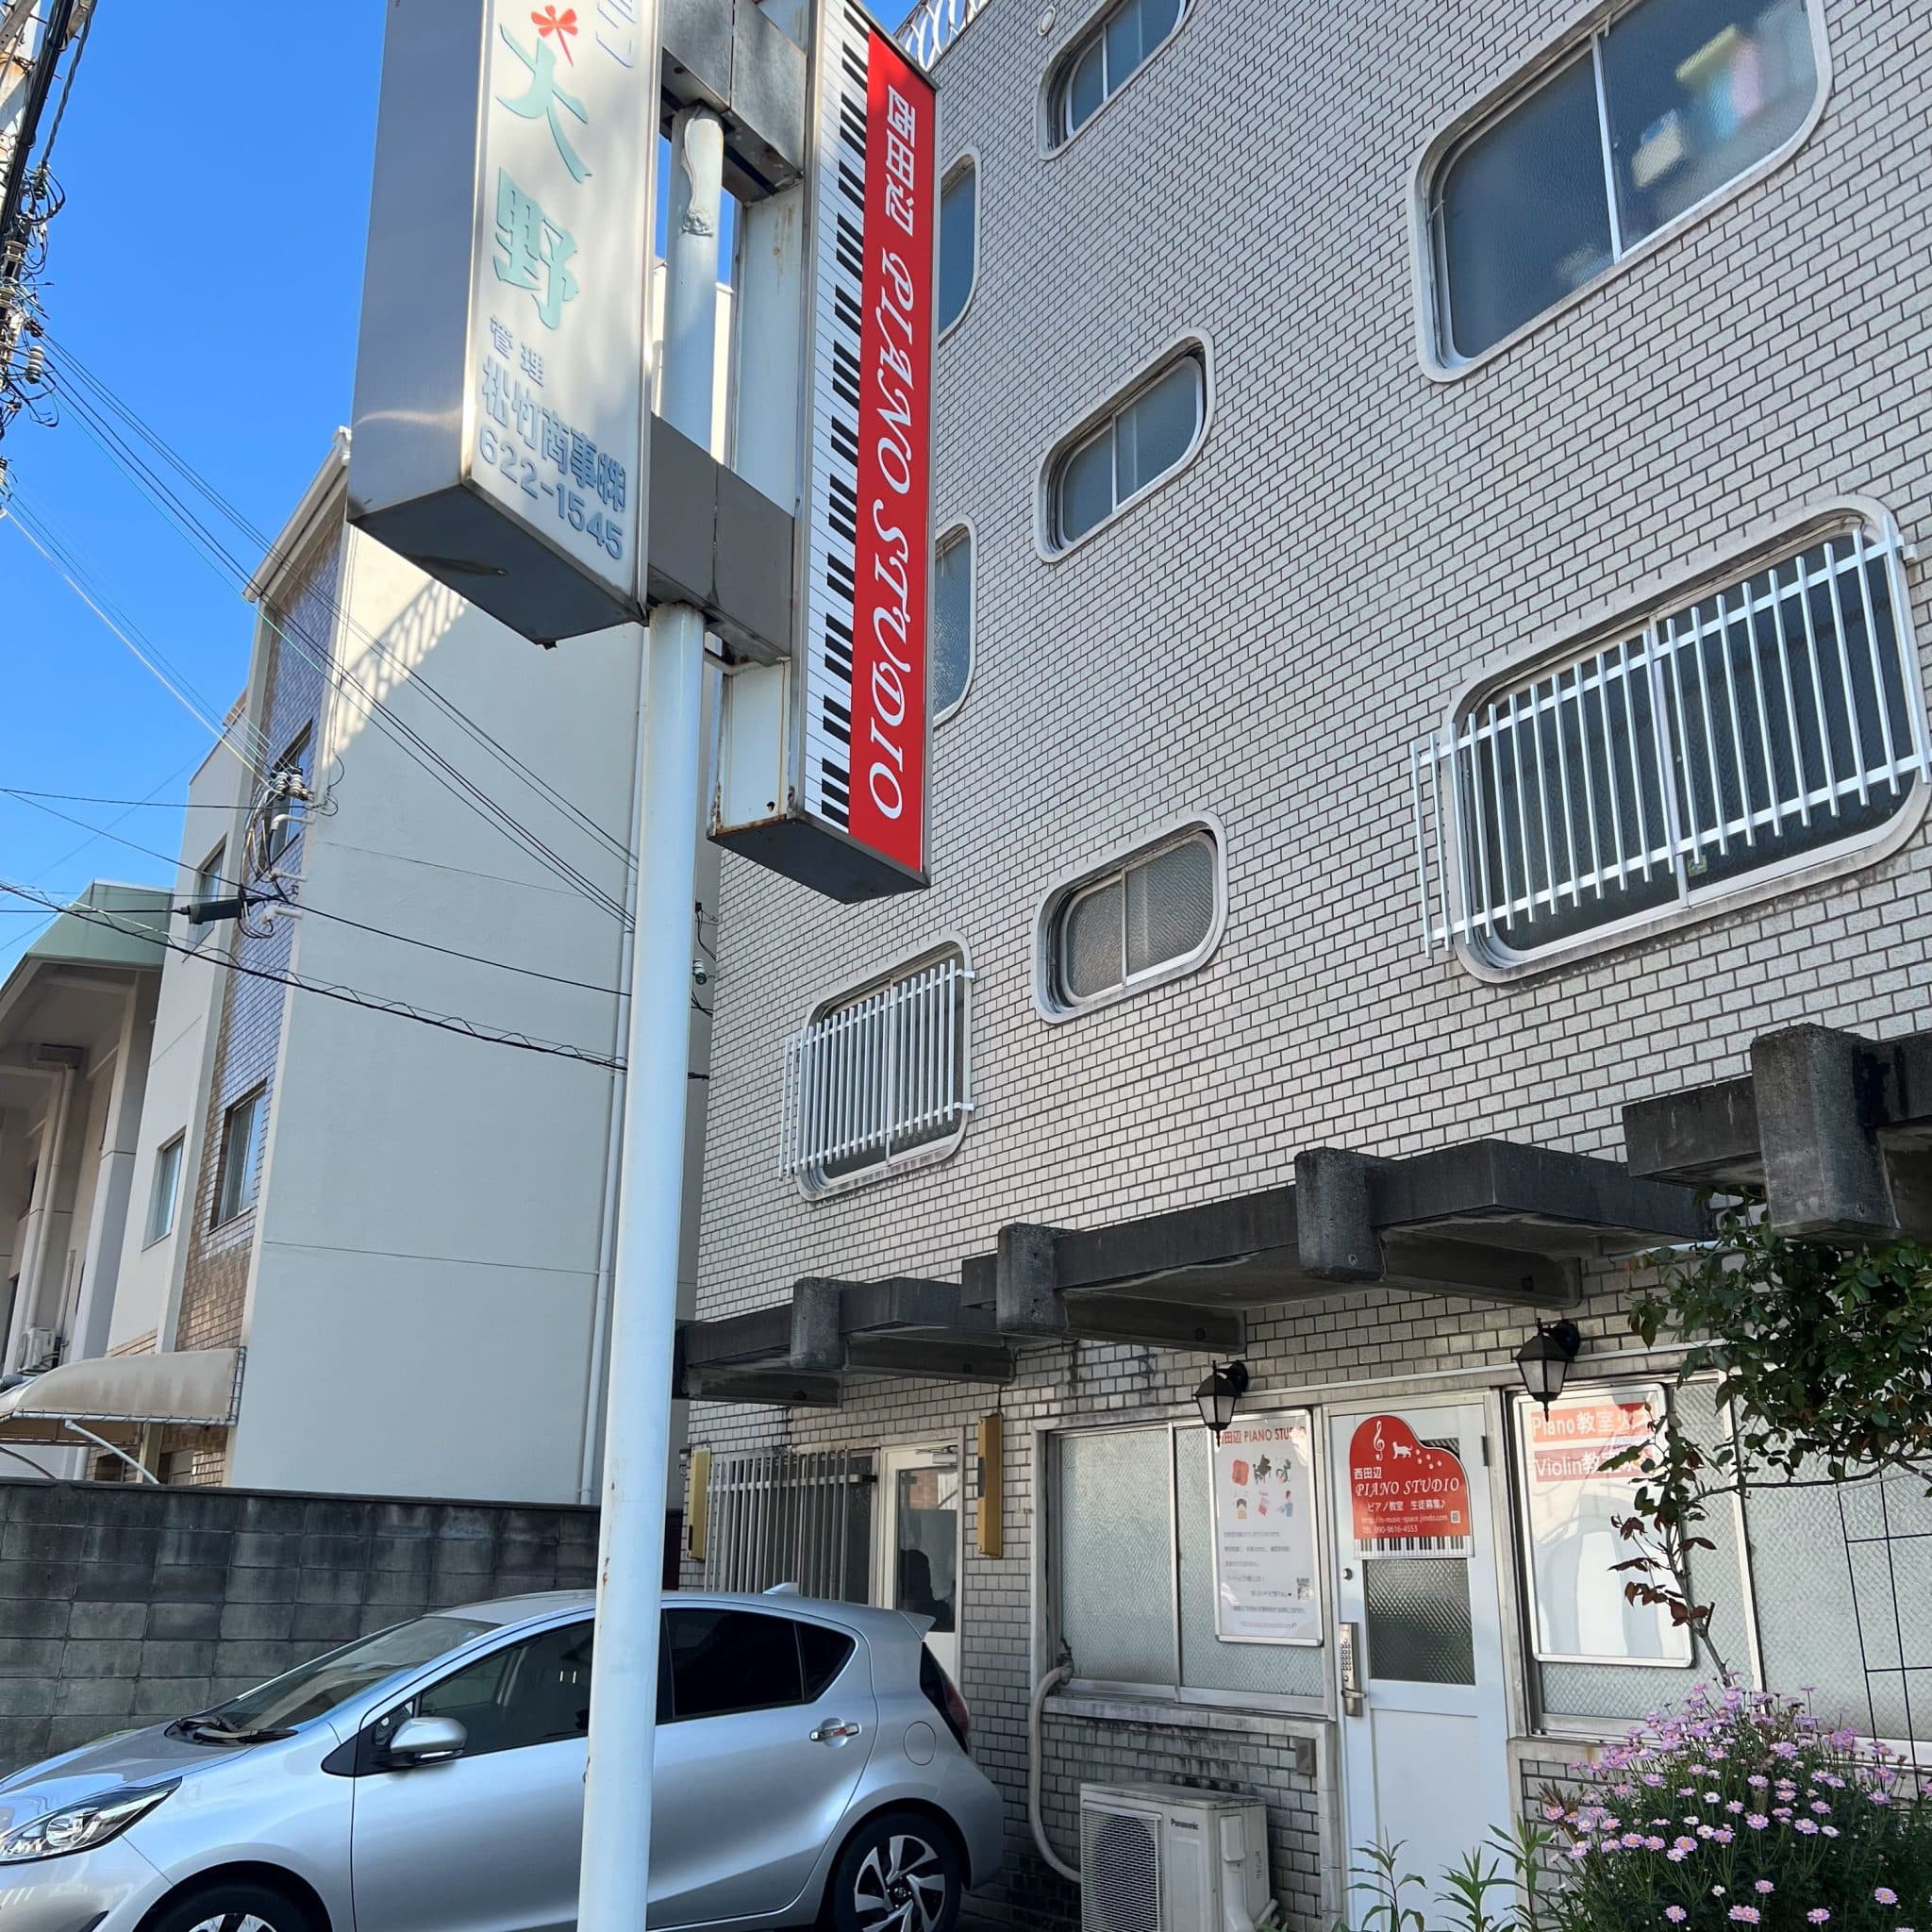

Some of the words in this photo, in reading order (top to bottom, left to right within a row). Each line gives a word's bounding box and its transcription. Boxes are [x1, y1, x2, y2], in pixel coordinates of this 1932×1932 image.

[885, 83, 917, 238] 西田辺
[874, 246, 915, 495] PIANO
[478, 425, 624, 560] 622-1545
[868, 498, 912, 821] STUDIO
[1243, 1428, 1273, 1442] PIANO
[1274, 1426, 1307, 1441] STU
[1354, 1466, 1382, 1480] 西田辺
[1356, 1480, 1400, 1498] PIANO
[1403, 1476, 1459, 1495] STUDIO
